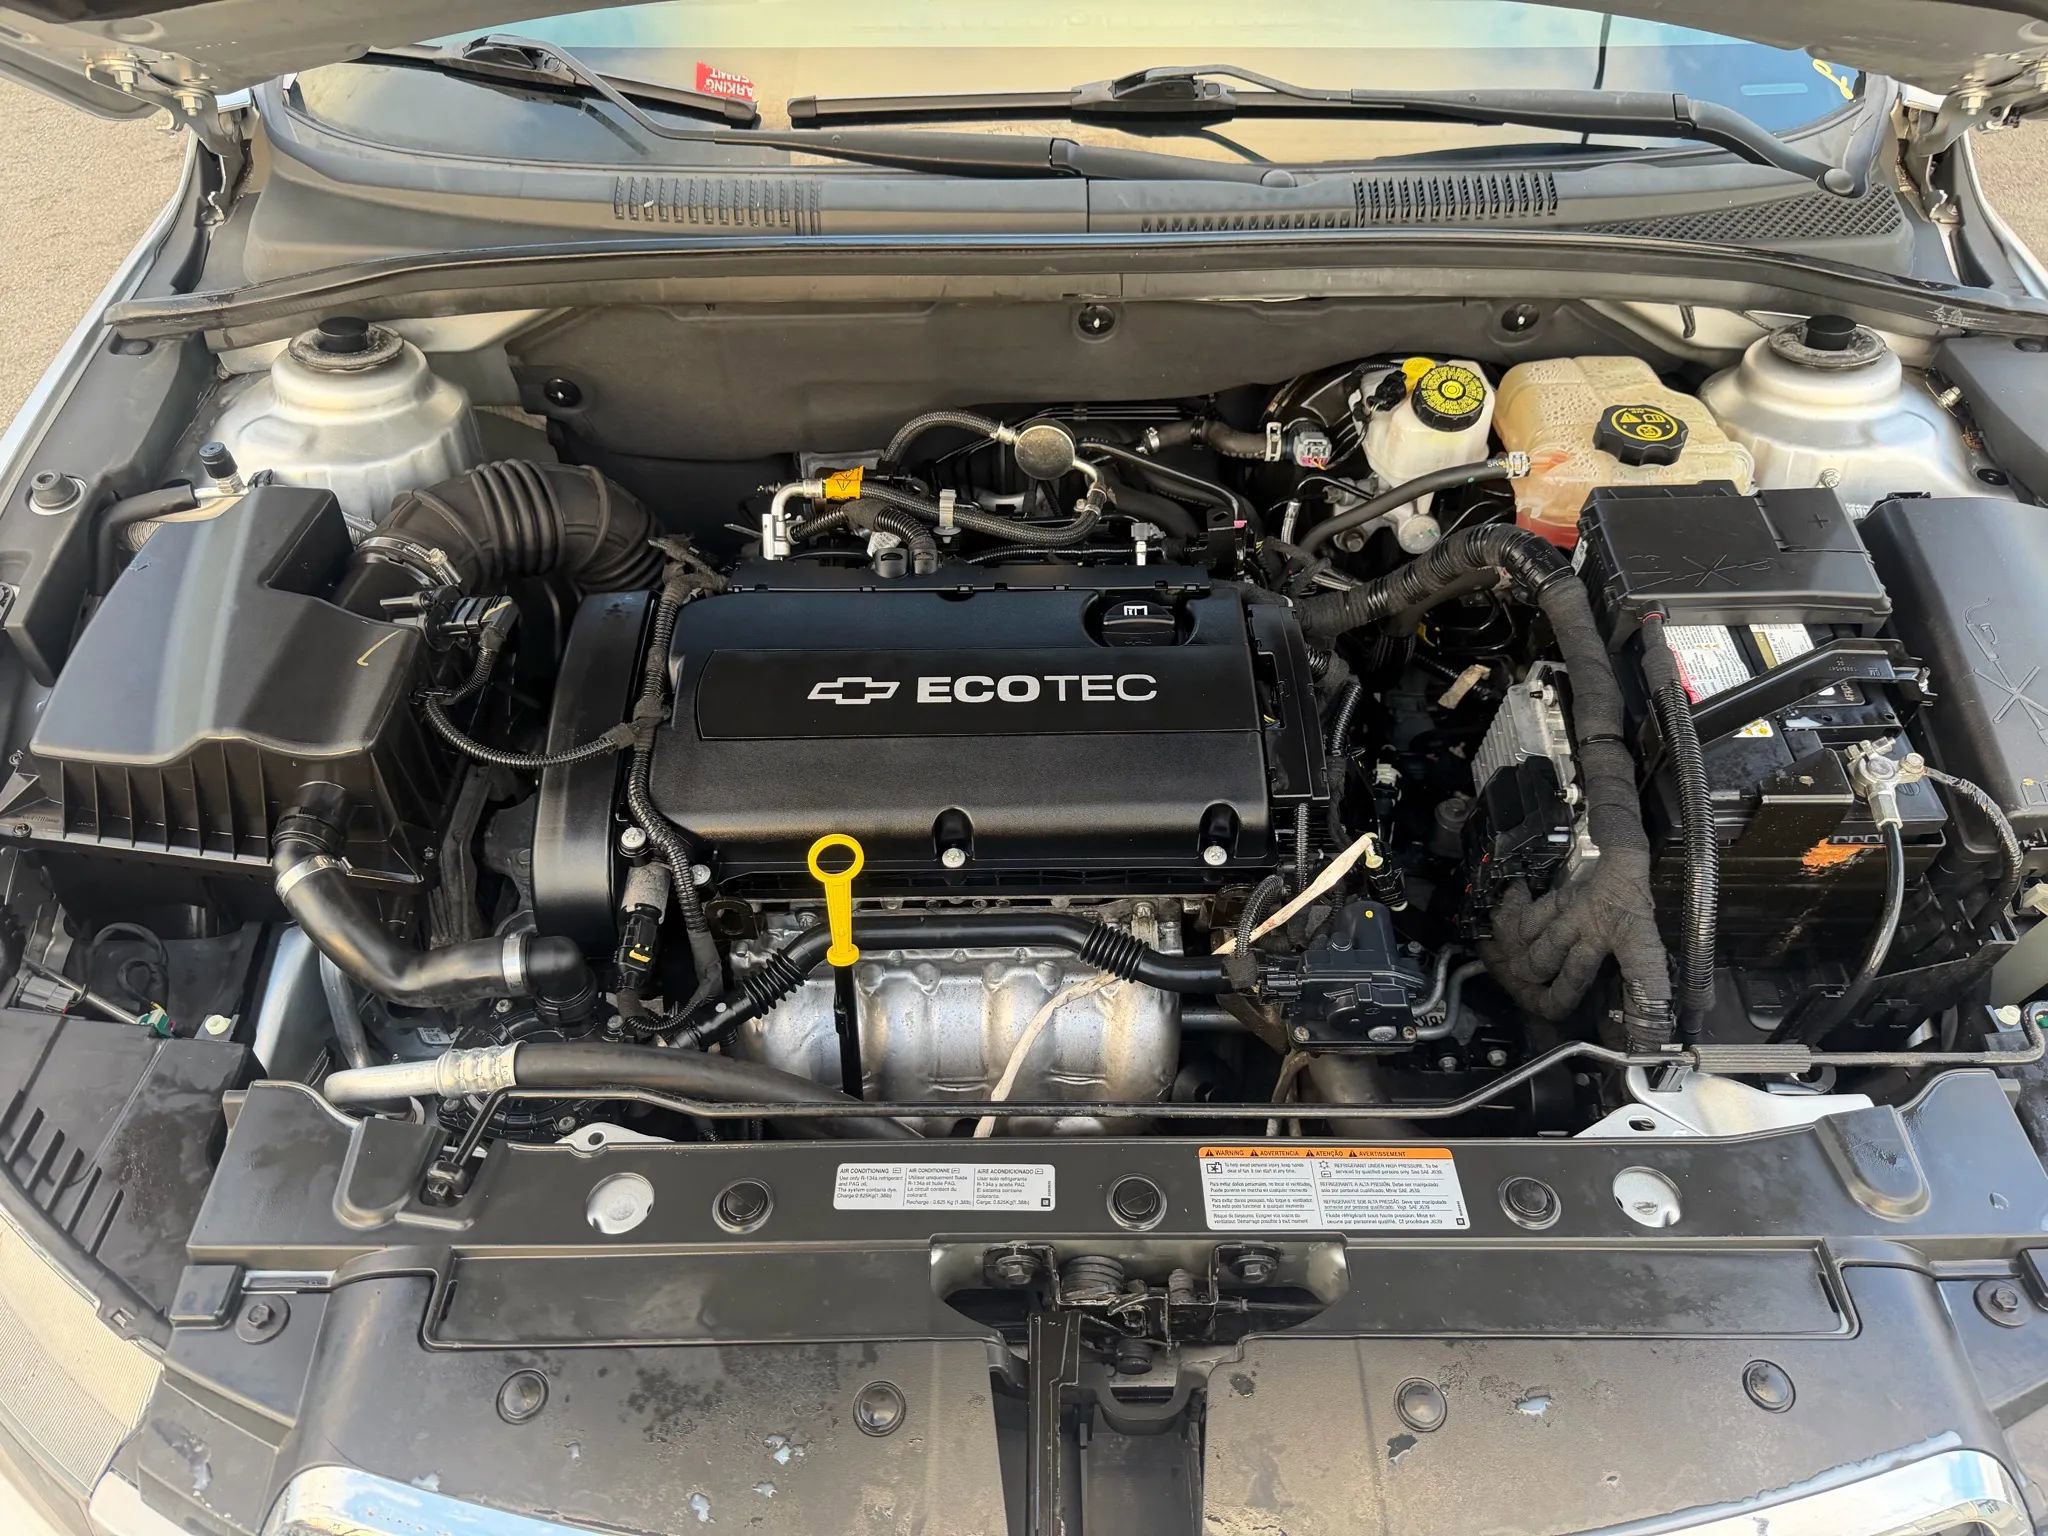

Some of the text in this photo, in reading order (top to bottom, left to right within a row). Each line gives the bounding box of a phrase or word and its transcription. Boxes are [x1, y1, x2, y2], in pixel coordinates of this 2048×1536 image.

[705, 78, 753, 96] ARKING
[917, 674, 1158, 703] ECOTEC
[1215, 1149, 1300, 1157] WARNING ADVERTENCIA
[1315, 1150, 1406, 1158] ATENÇÃO AVERTISSEMENT
